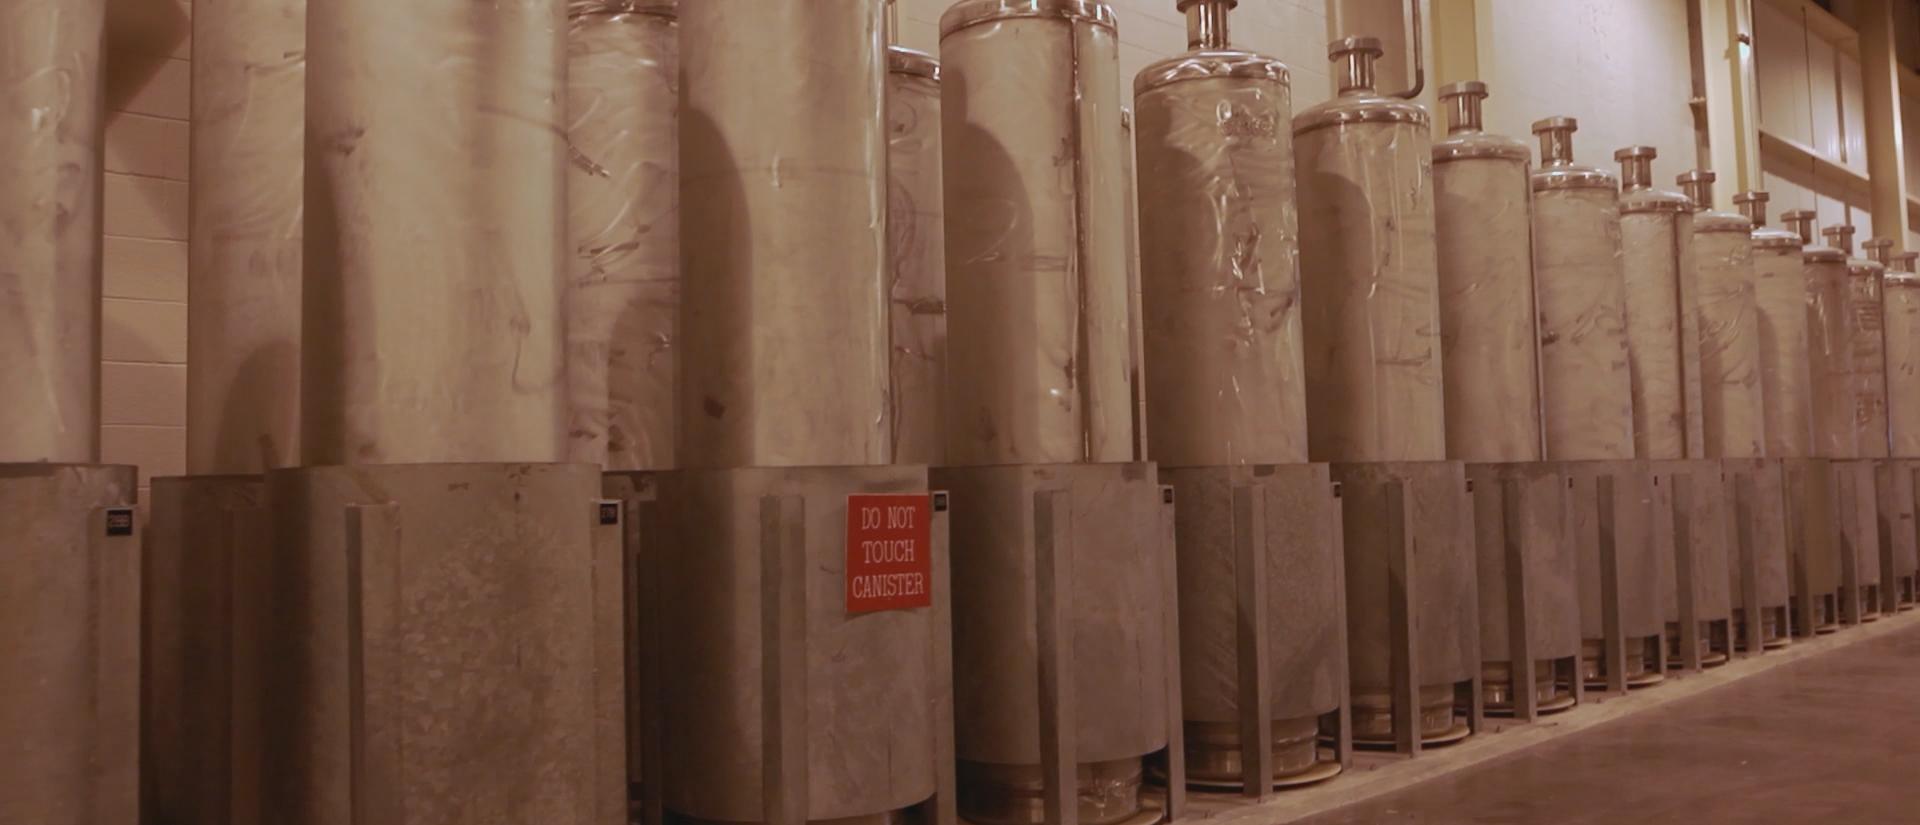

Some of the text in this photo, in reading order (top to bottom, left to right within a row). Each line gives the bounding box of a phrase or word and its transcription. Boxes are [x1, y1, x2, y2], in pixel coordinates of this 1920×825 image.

[862, 506, 915, 529] DO NOT
[862, 540, 914, 563] TOUCH
[852, 572, 924, 598] CANISTER
